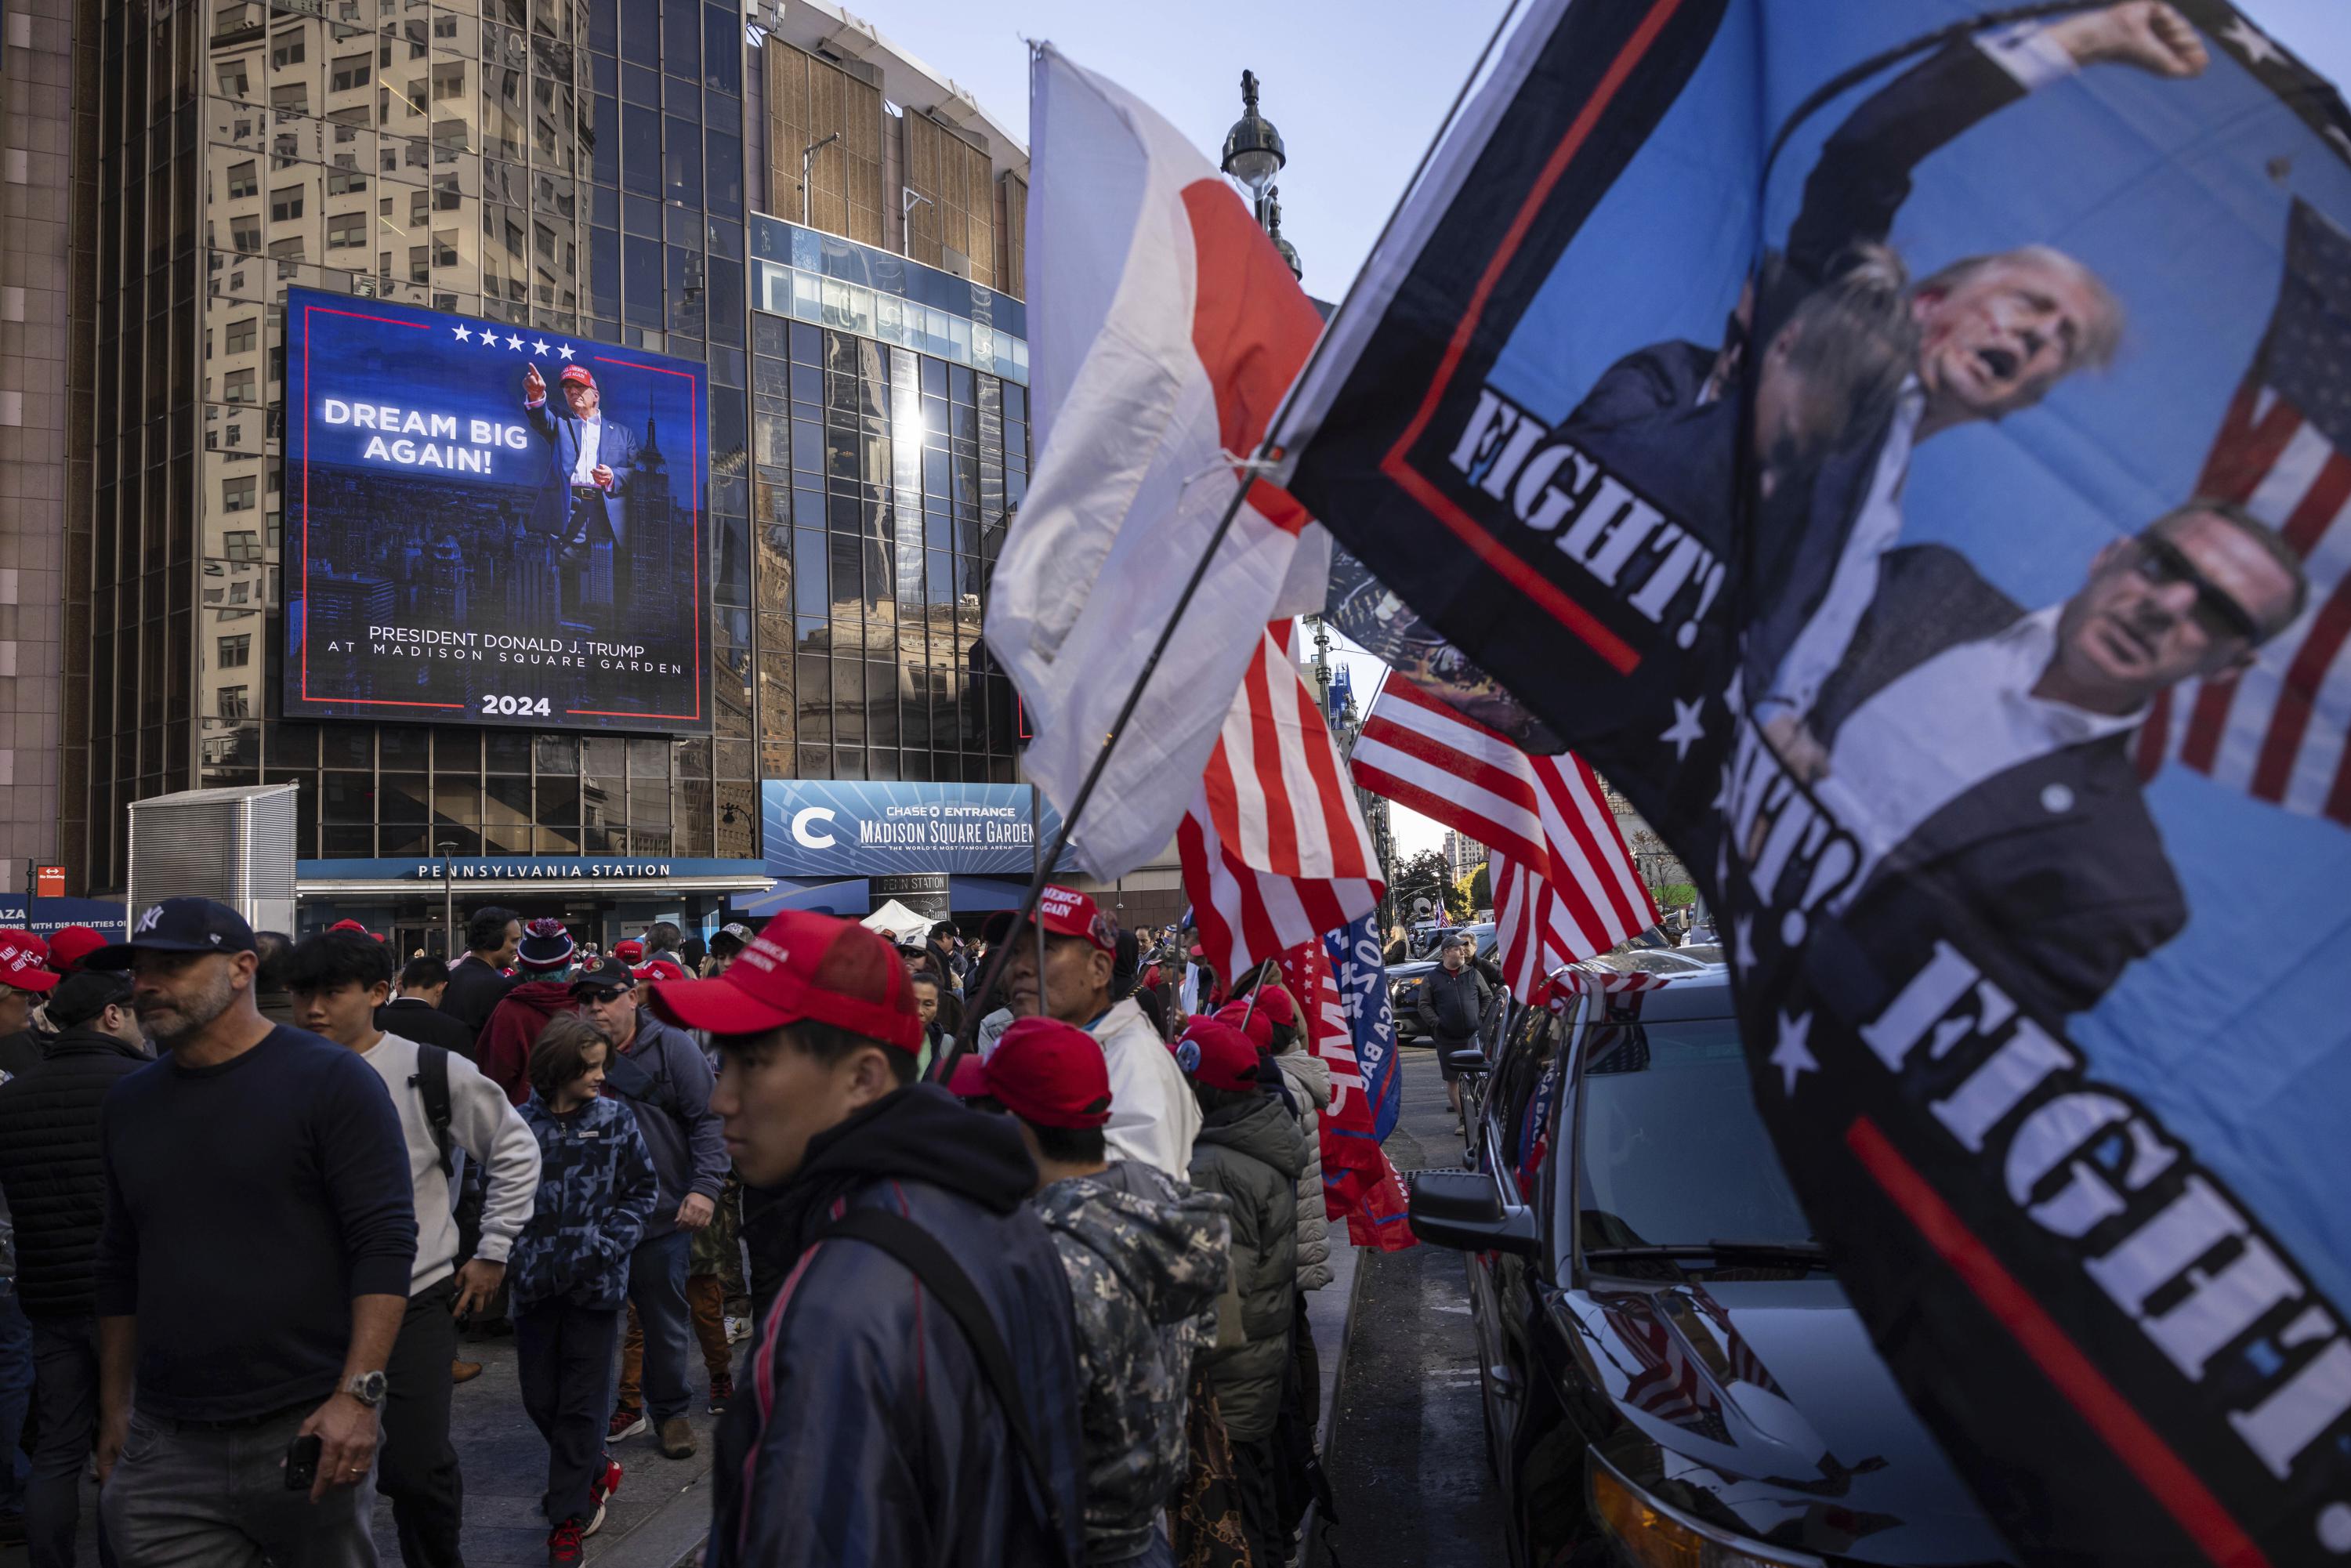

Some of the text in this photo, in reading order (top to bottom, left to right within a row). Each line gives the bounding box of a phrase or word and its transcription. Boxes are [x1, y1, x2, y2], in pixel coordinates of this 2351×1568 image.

[325, 399, 527, 449] DREAM BIG
[364, 436, 491, 474] AGAIN!
[1449, 388, 1727, 650] FIGHT!
[328, 641, 681, 674] AT MADISON SQUARE GARDEN
[370, 626, 644, 658] PRESIDENT DONALD J. TRUMP
[482, 694, 551, 716] 2024
[792, 806, 836, 849] C
[886, 806, 1015, 817] CHASE ENTRANCE
[860, 820, 925, 843] MADISON
[930, 820, 981, 845] SQUARE
[986, 820, 1035, 843] GARDEN
[418, 864, 670, 877] PENNSYLVANIA STATION
[883, 877, 944, 890] PENN STATION
